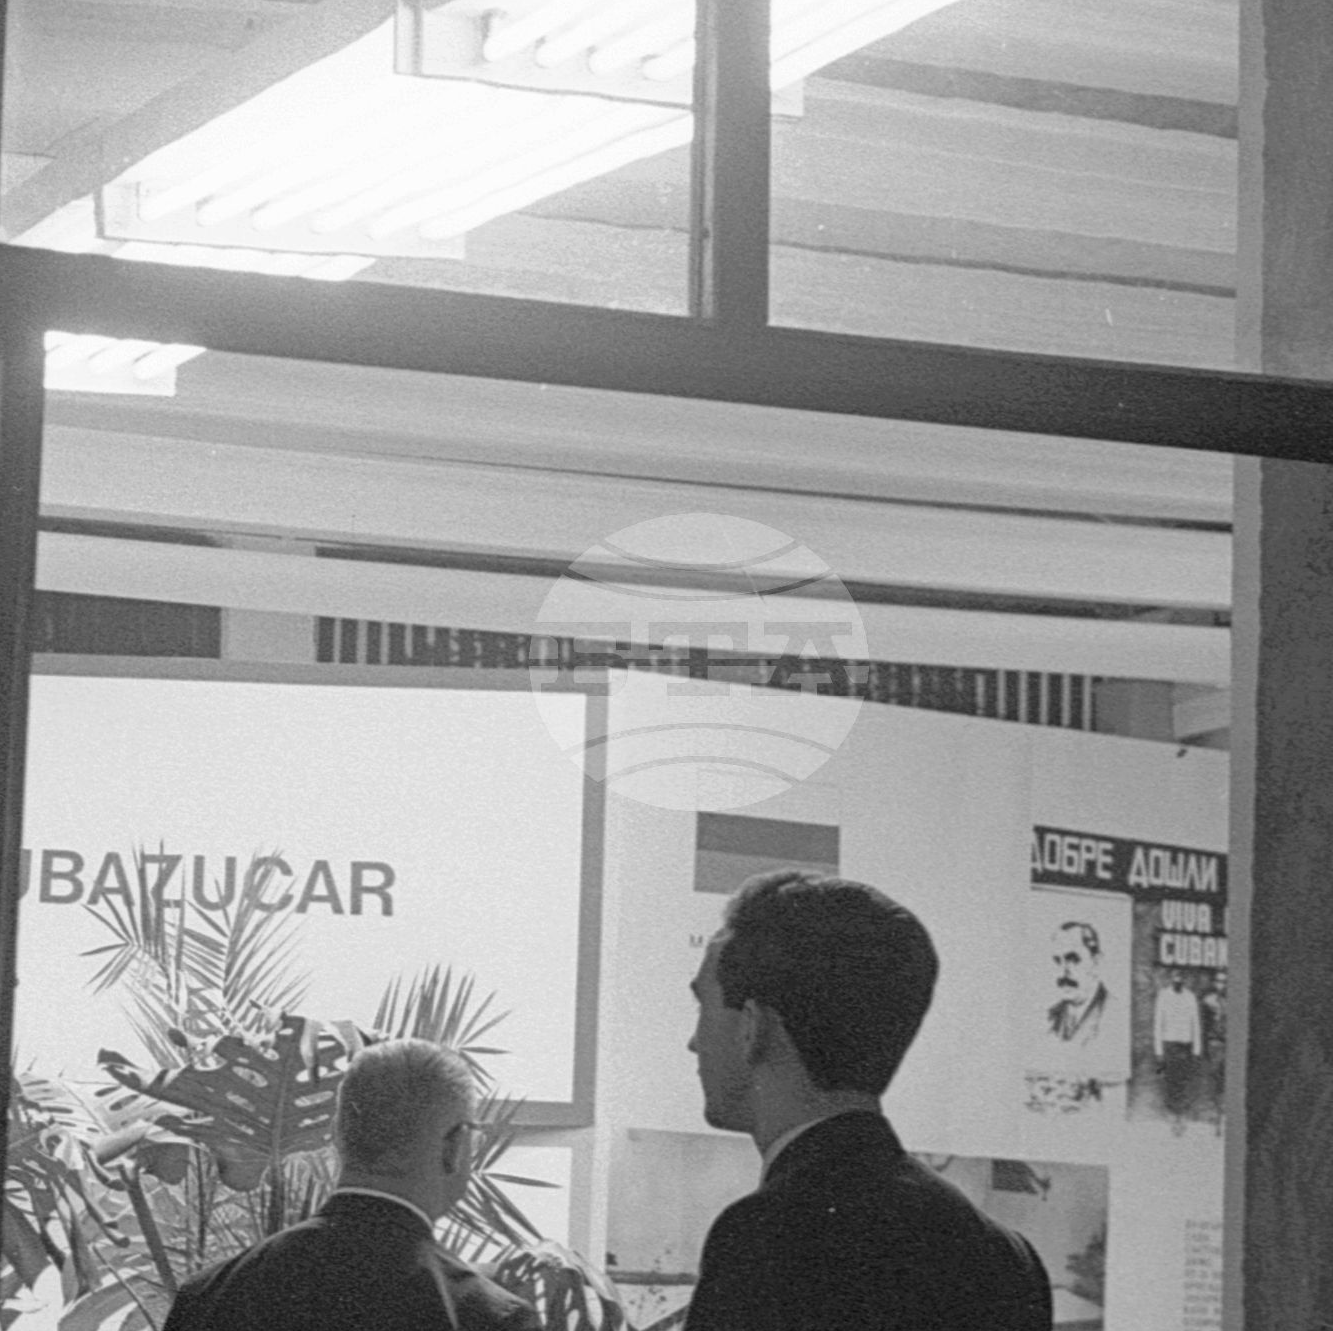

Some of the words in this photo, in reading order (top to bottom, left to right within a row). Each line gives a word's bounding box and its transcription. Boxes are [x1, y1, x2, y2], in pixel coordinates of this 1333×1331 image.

[20, 848, 397, 917] BAZUCAR
[1128, 846, 1219, 893] ДОШЛИ
[1161, 899, 1212, 933] VIVA
